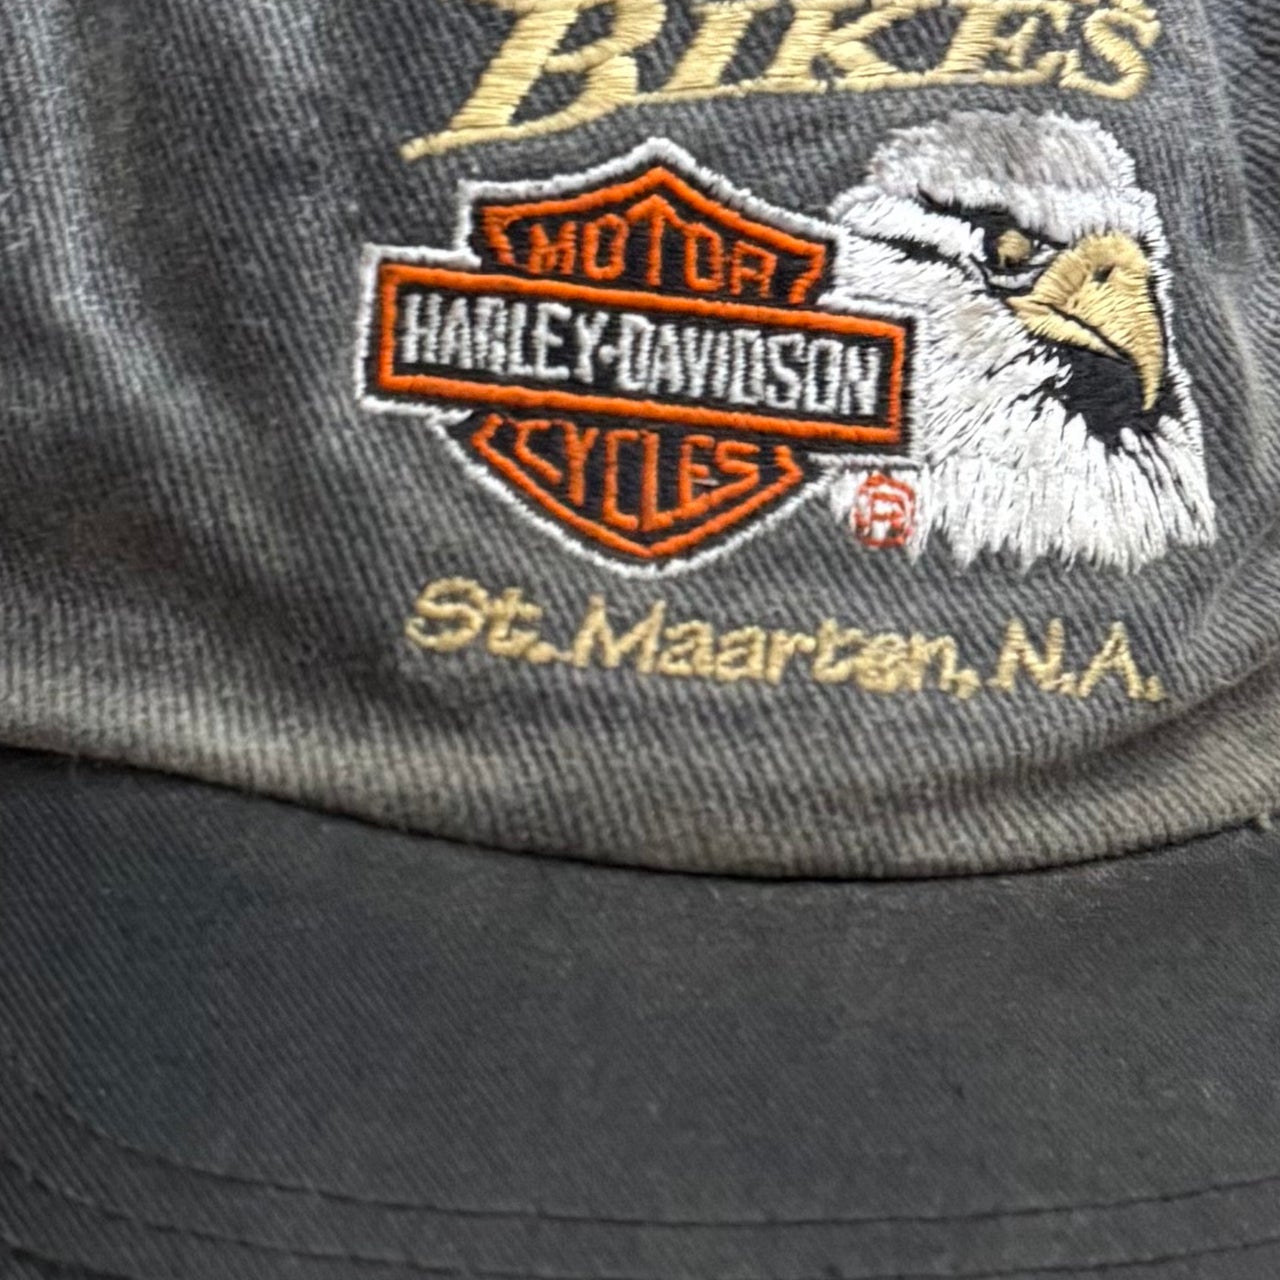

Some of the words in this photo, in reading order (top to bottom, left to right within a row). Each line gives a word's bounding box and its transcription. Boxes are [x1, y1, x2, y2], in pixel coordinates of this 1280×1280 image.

[526, 196, 776, 298] MOTOR
[400, 293, 881, 416] HARLEY-DAVIDSON
[515, 420, 761, 531] CYCLES
[405, 576, 562, 665] St.
[572, 595, 978, 701] Maarten,
[988, 619, 1165, 703] N.A.
